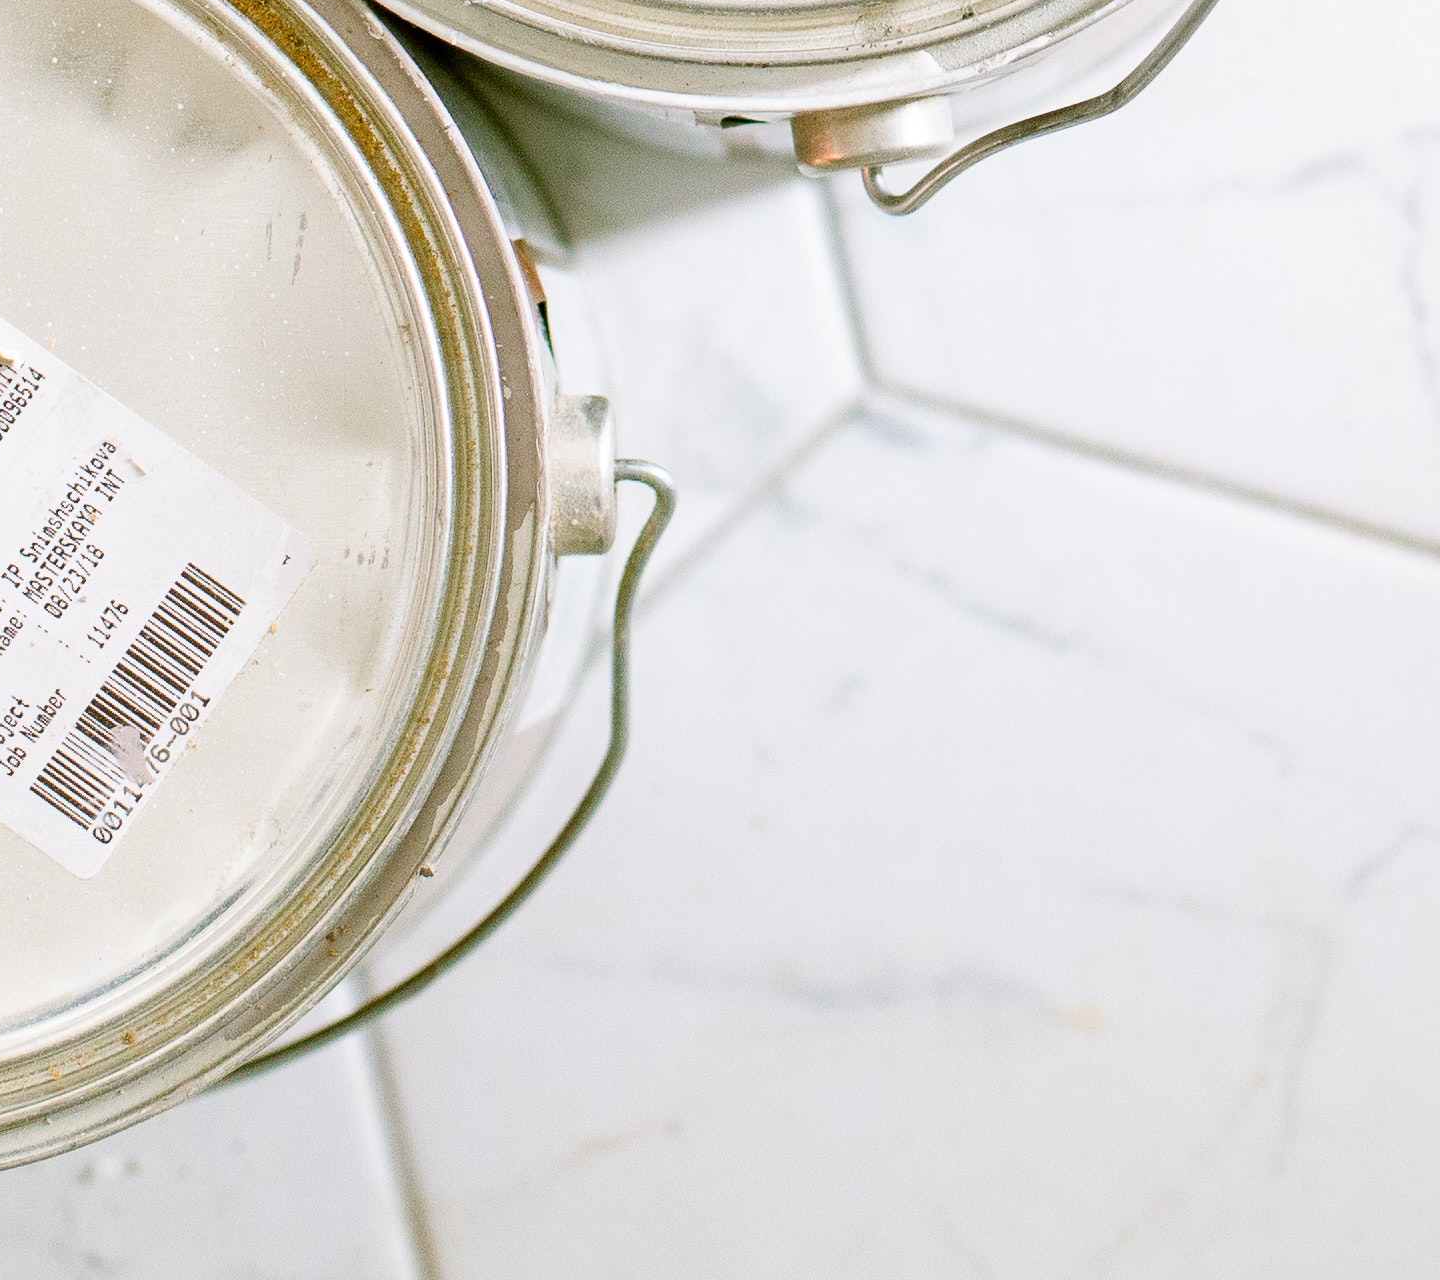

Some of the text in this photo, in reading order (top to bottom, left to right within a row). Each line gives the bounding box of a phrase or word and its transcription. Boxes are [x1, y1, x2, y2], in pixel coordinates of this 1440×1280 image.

[0, 562, 24, 589] IP
[18, 440, 117, 564] Snimshschikova
[20, 502, 103, 605] MASTERSKAYA
[93, 467, 125, 502] INT
[42, 543, 105, 619] 08/23/18
[18, 687, 67, 744] Number
[86, 598, 129, 649] 11476
[91, 689, 211, 845] 00116-001
